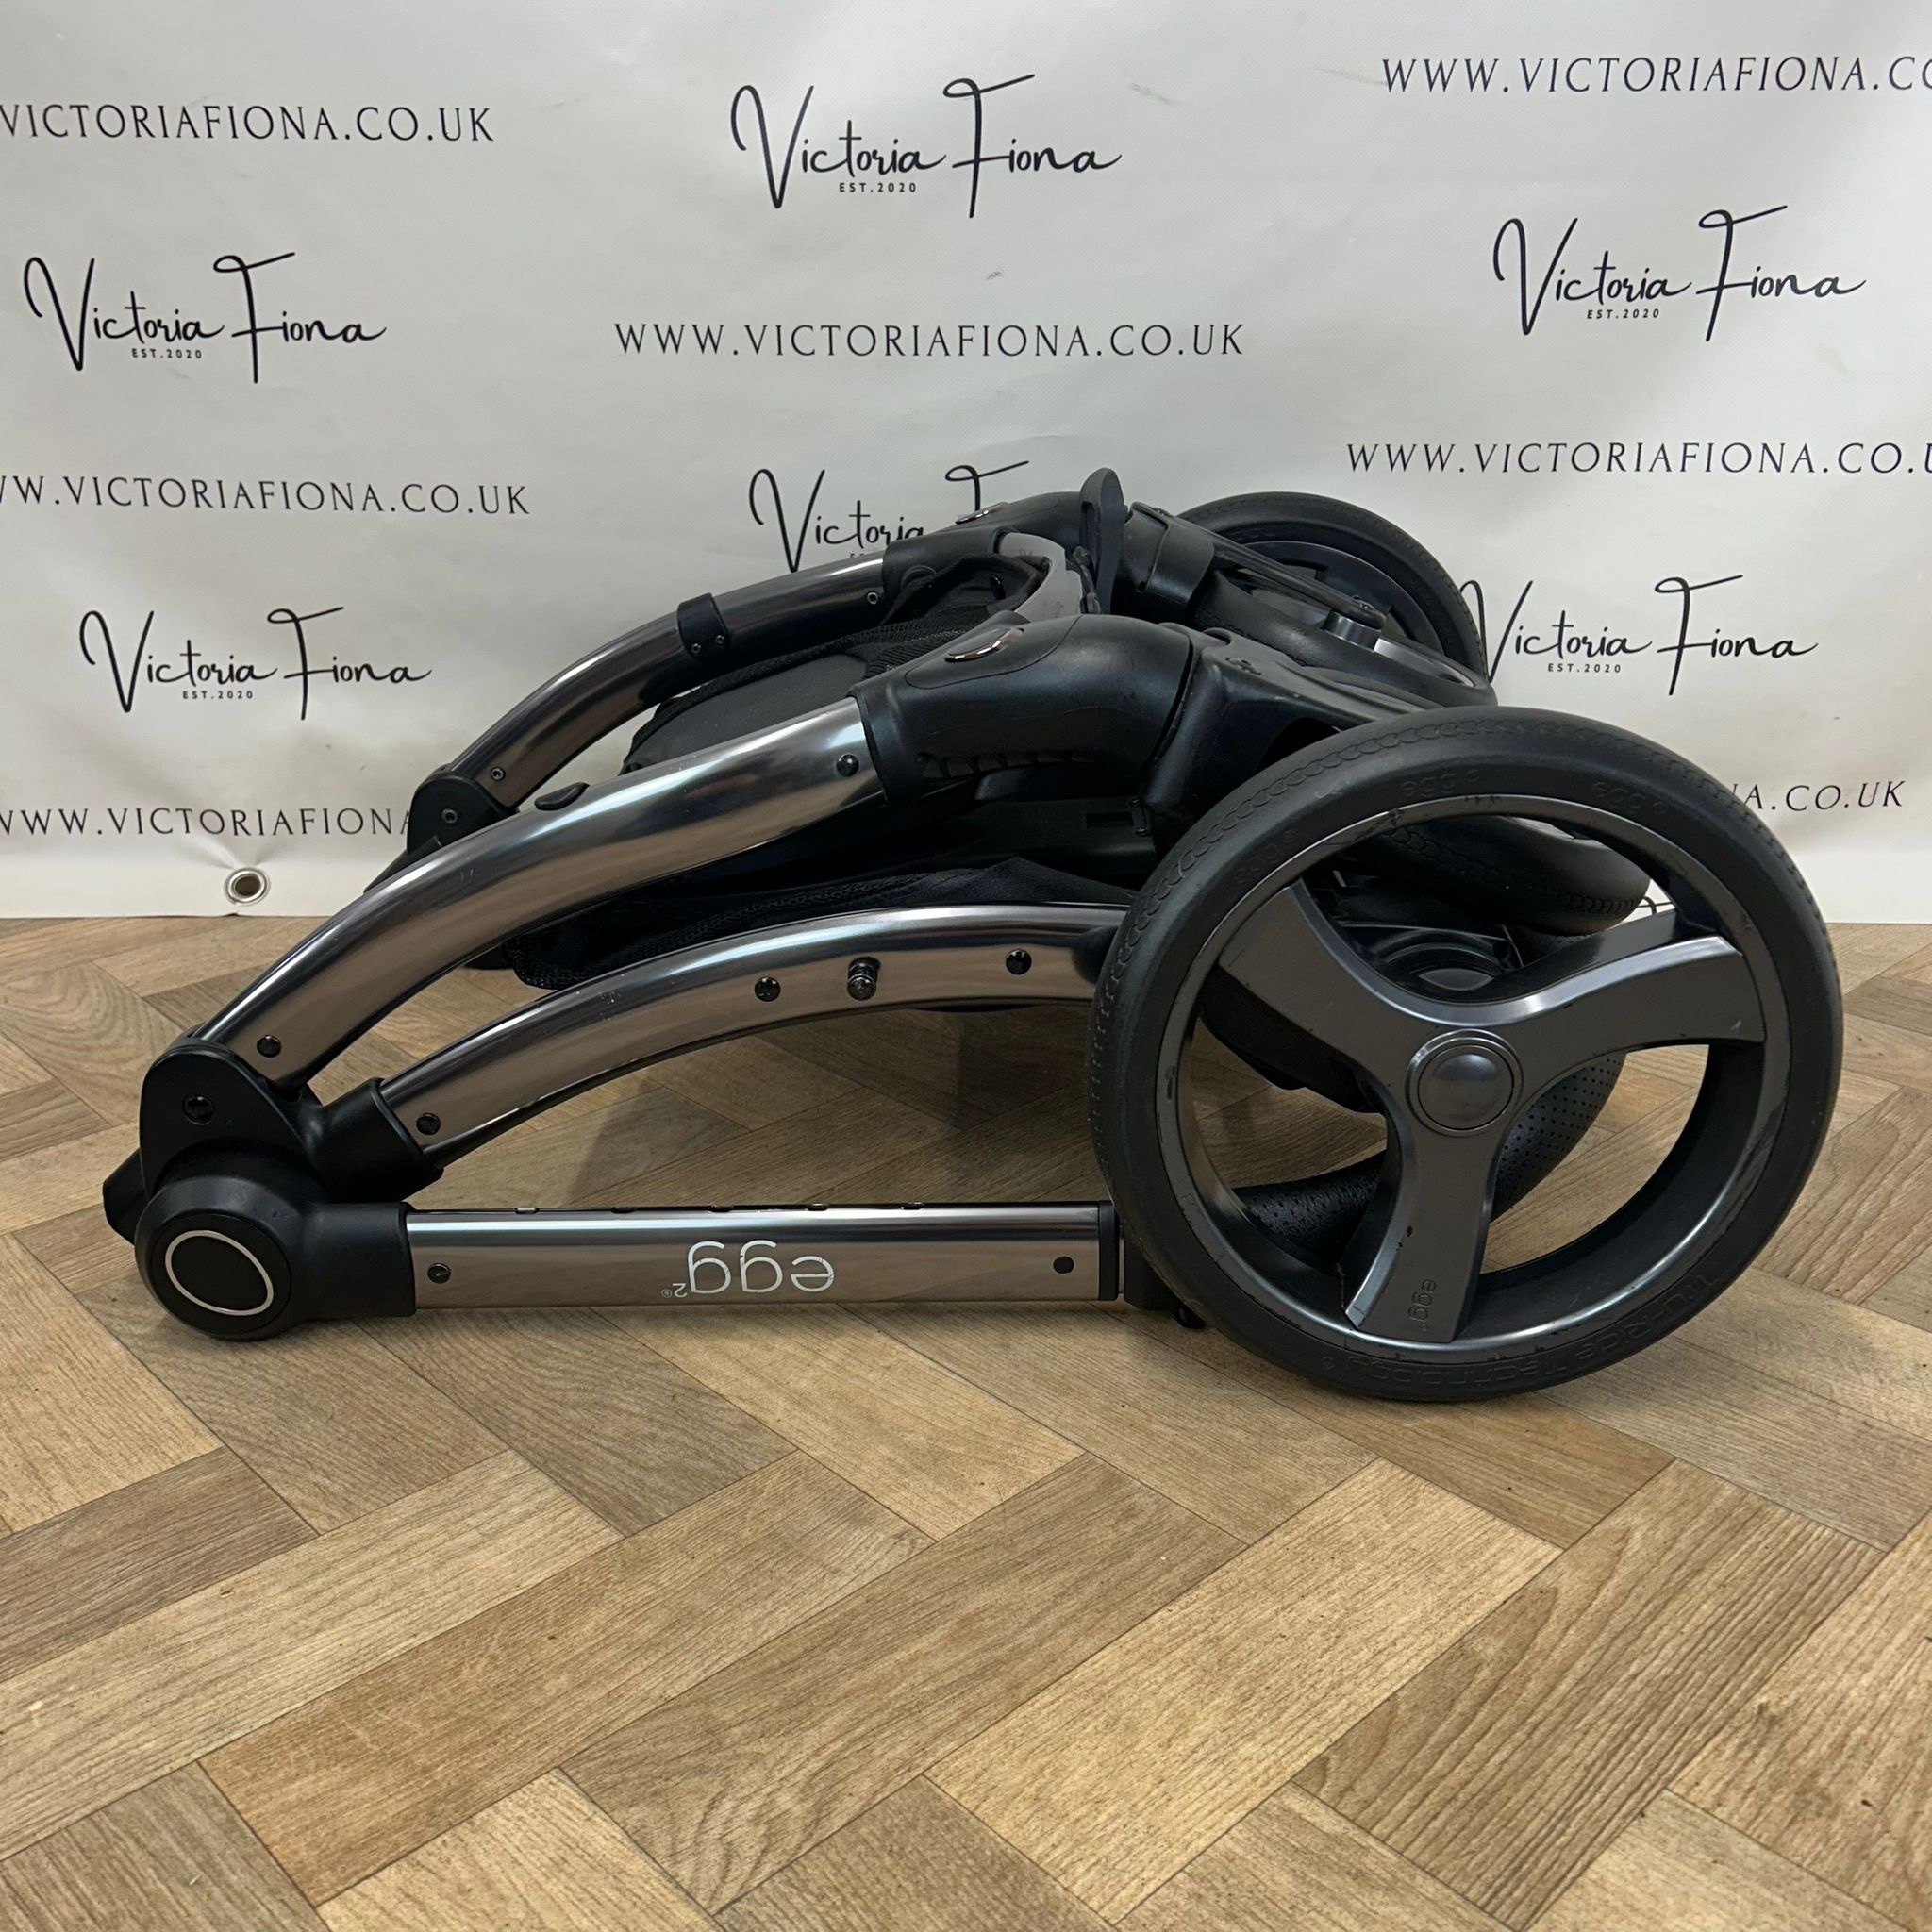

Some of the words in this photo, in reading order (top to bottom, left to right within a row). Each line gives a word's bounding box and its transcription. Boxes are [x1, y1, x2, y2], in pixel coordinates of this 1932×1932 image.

[731, 85, 946, 209] Victoria
[943, 75, 1122, 218] Fiona
[839, 182, 917, 193] EST.2020
[1492, 218, 1691, 335] Victoria
[1696, 205, 1866, 341] Fiona
[24, 257, 225, 371] Victoria
[213, 252, 387, 384] Fiona
[1586, 309, 1660, 319] EST.2020
[131, 347, 202, 359] EST.2020
[614, 323, 1244, 357] WWW.VICTORIAFIONA.CO.UK
[0, 475, 530, 515] W.VICTORIAFIONA.CO.UK
[1459, 580, 1653, 683] Victoria
[1654, 575, 1819, 696] Fiona
[79, 610, 277, 713] Victoria
[267, 607, 432, 721] Fiona
[1547, 662, 1622, 674] EST.2020
[182, 690, 254, 700] EST.2020
